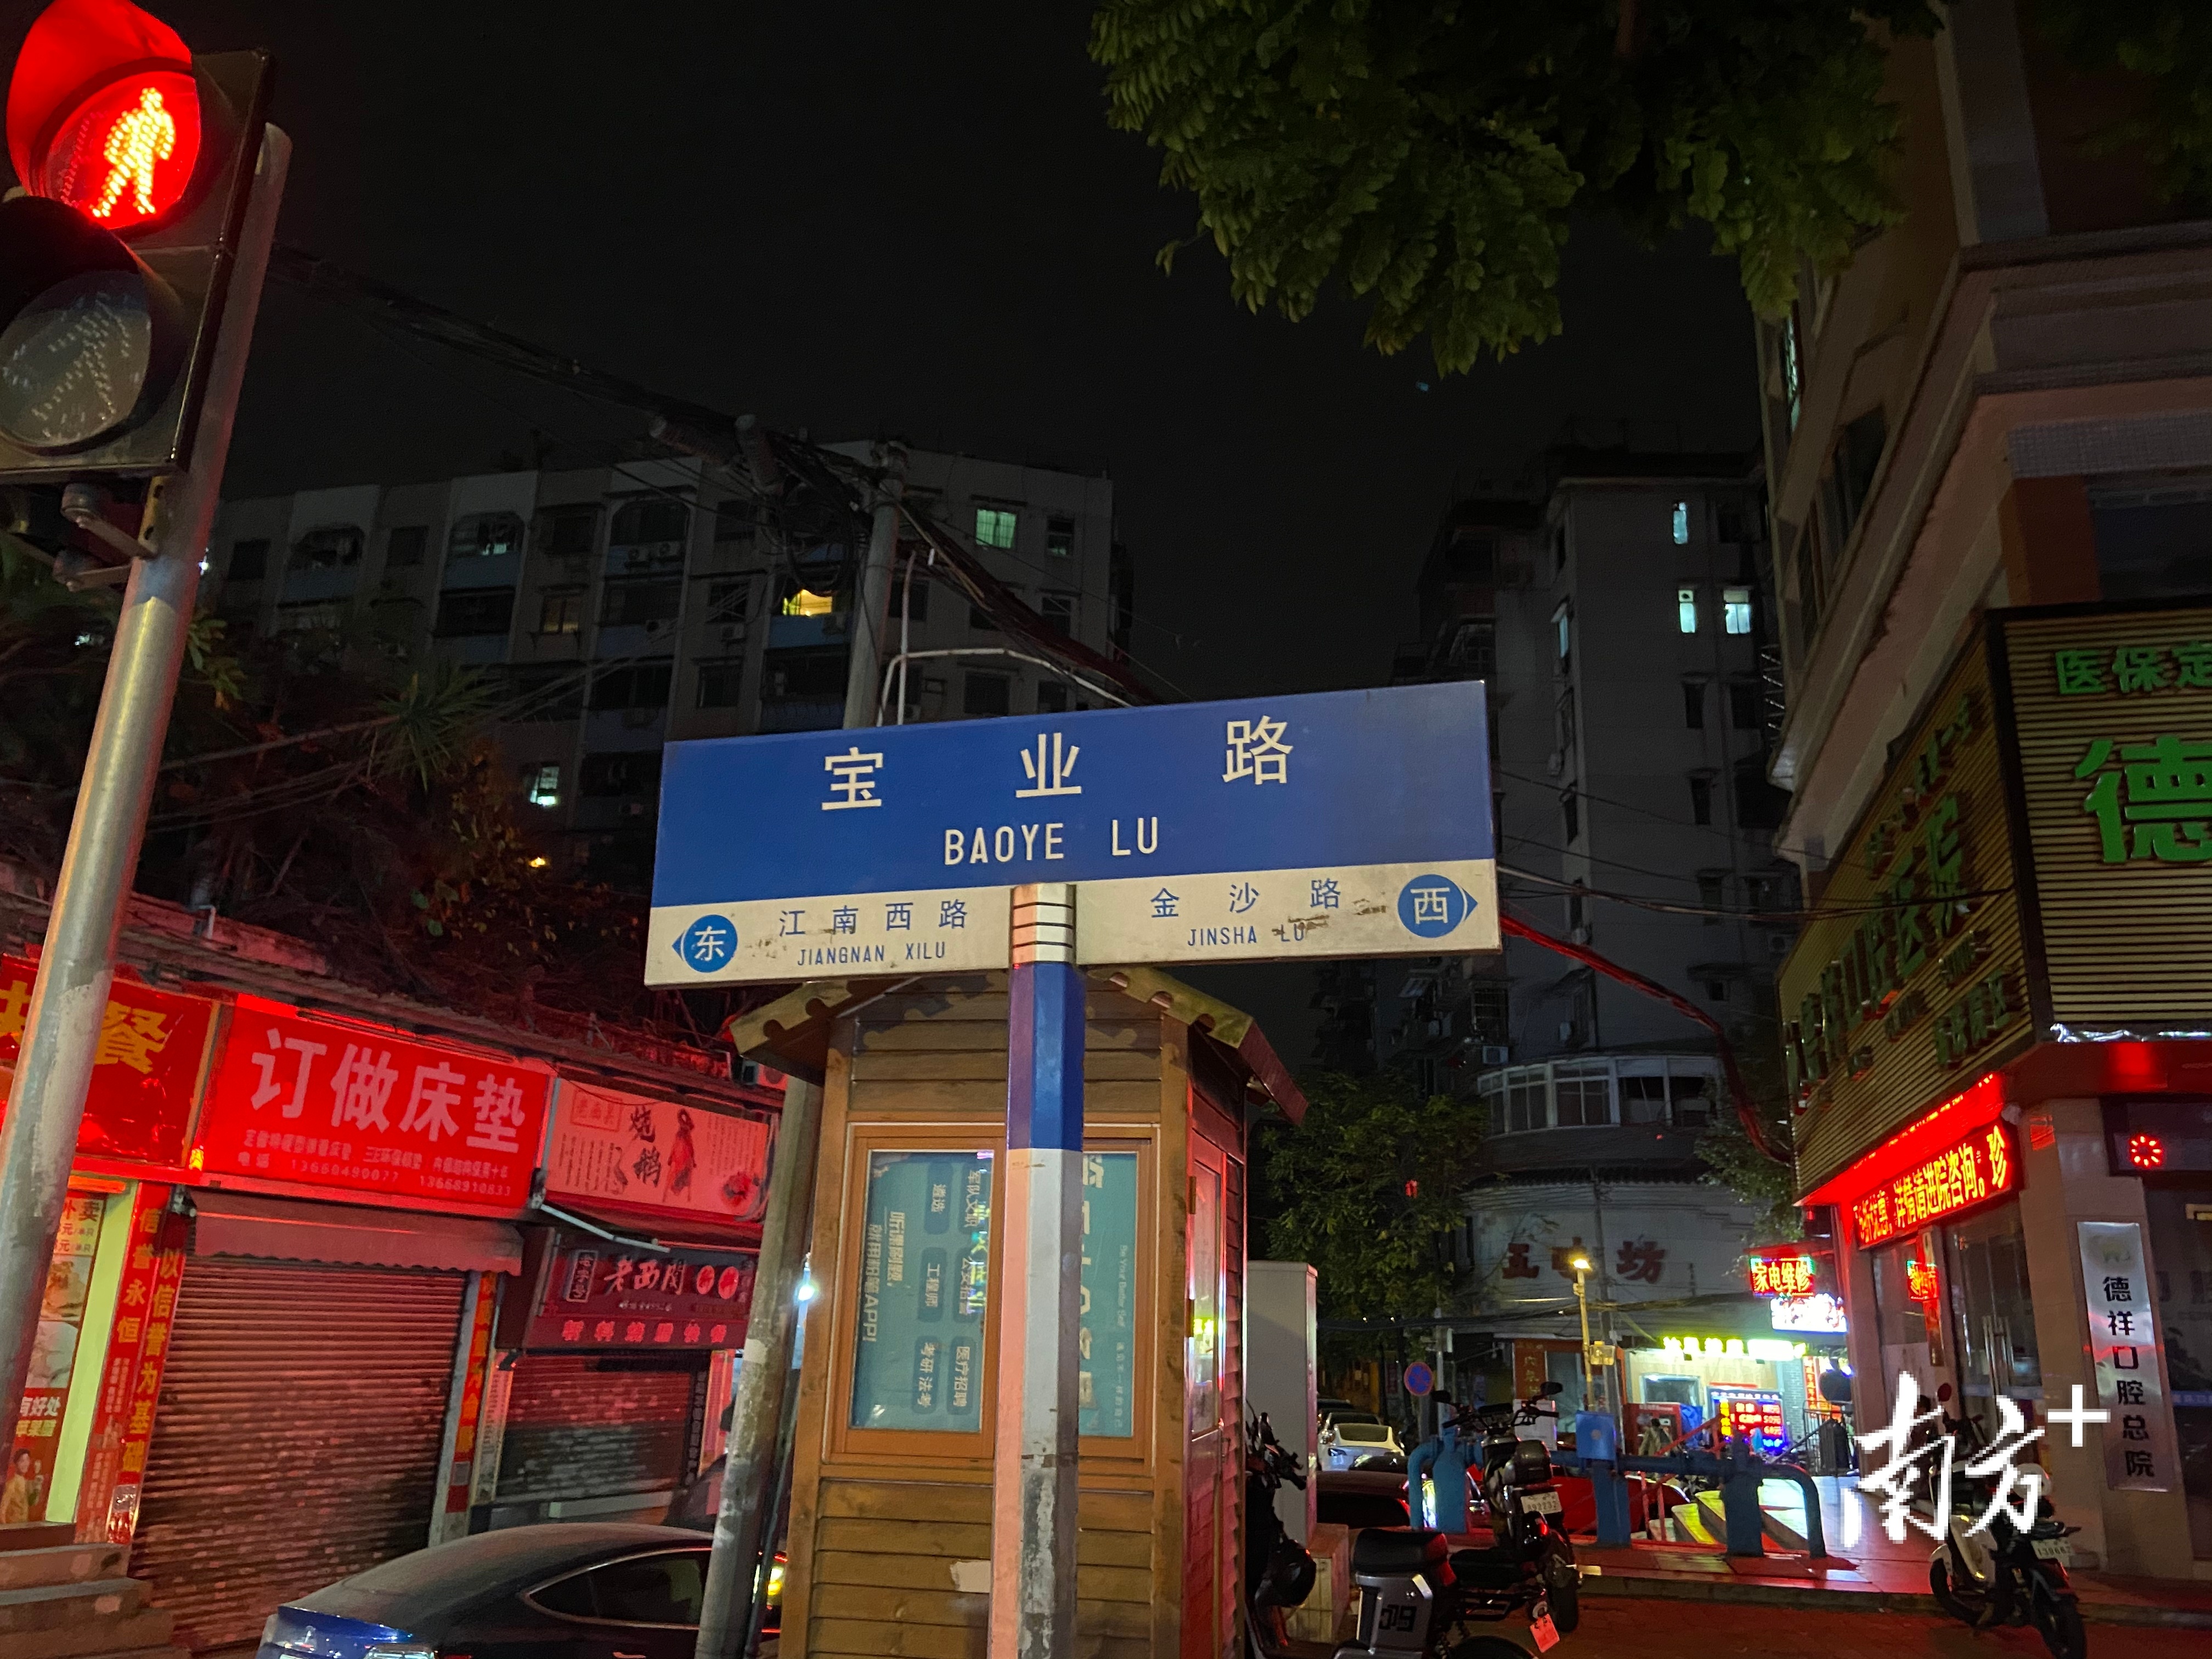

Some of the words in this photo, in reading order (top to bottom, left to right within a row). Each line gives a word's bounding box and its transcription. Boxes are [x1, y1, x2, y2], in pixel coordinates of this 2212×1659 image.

[821, 715, 1294, 813] 宝业路
[945, 823, 1064, 866] BAOYE
[1112, 816, 1158, 856] LU
[778, 899, 968, 938] 江南西路
[1150, 879, 1341, 919] 金沙路
[1410, 886, 1451, 925] 西
[694, 926, 727, 962] 东
[797, 944, 885, 966] JIANGNAN
[905, 940, 946, 961] XILU
[1187, 925, 1258, 947] JINSHA
[1280, 922, 1306, 943] LU
[251, 1028, 525, 1153] 订做床垫
[116, 1209, 161, 1344] 信誉永恒
[926, 1262, 940, 1308] 工程师
[1754, 1261, 1810, 1294] 家电维修
[952, 1346, 971, 1408] 医疗招聘
[2102, 1276, 2155, 1477] 德祥口腔总院
